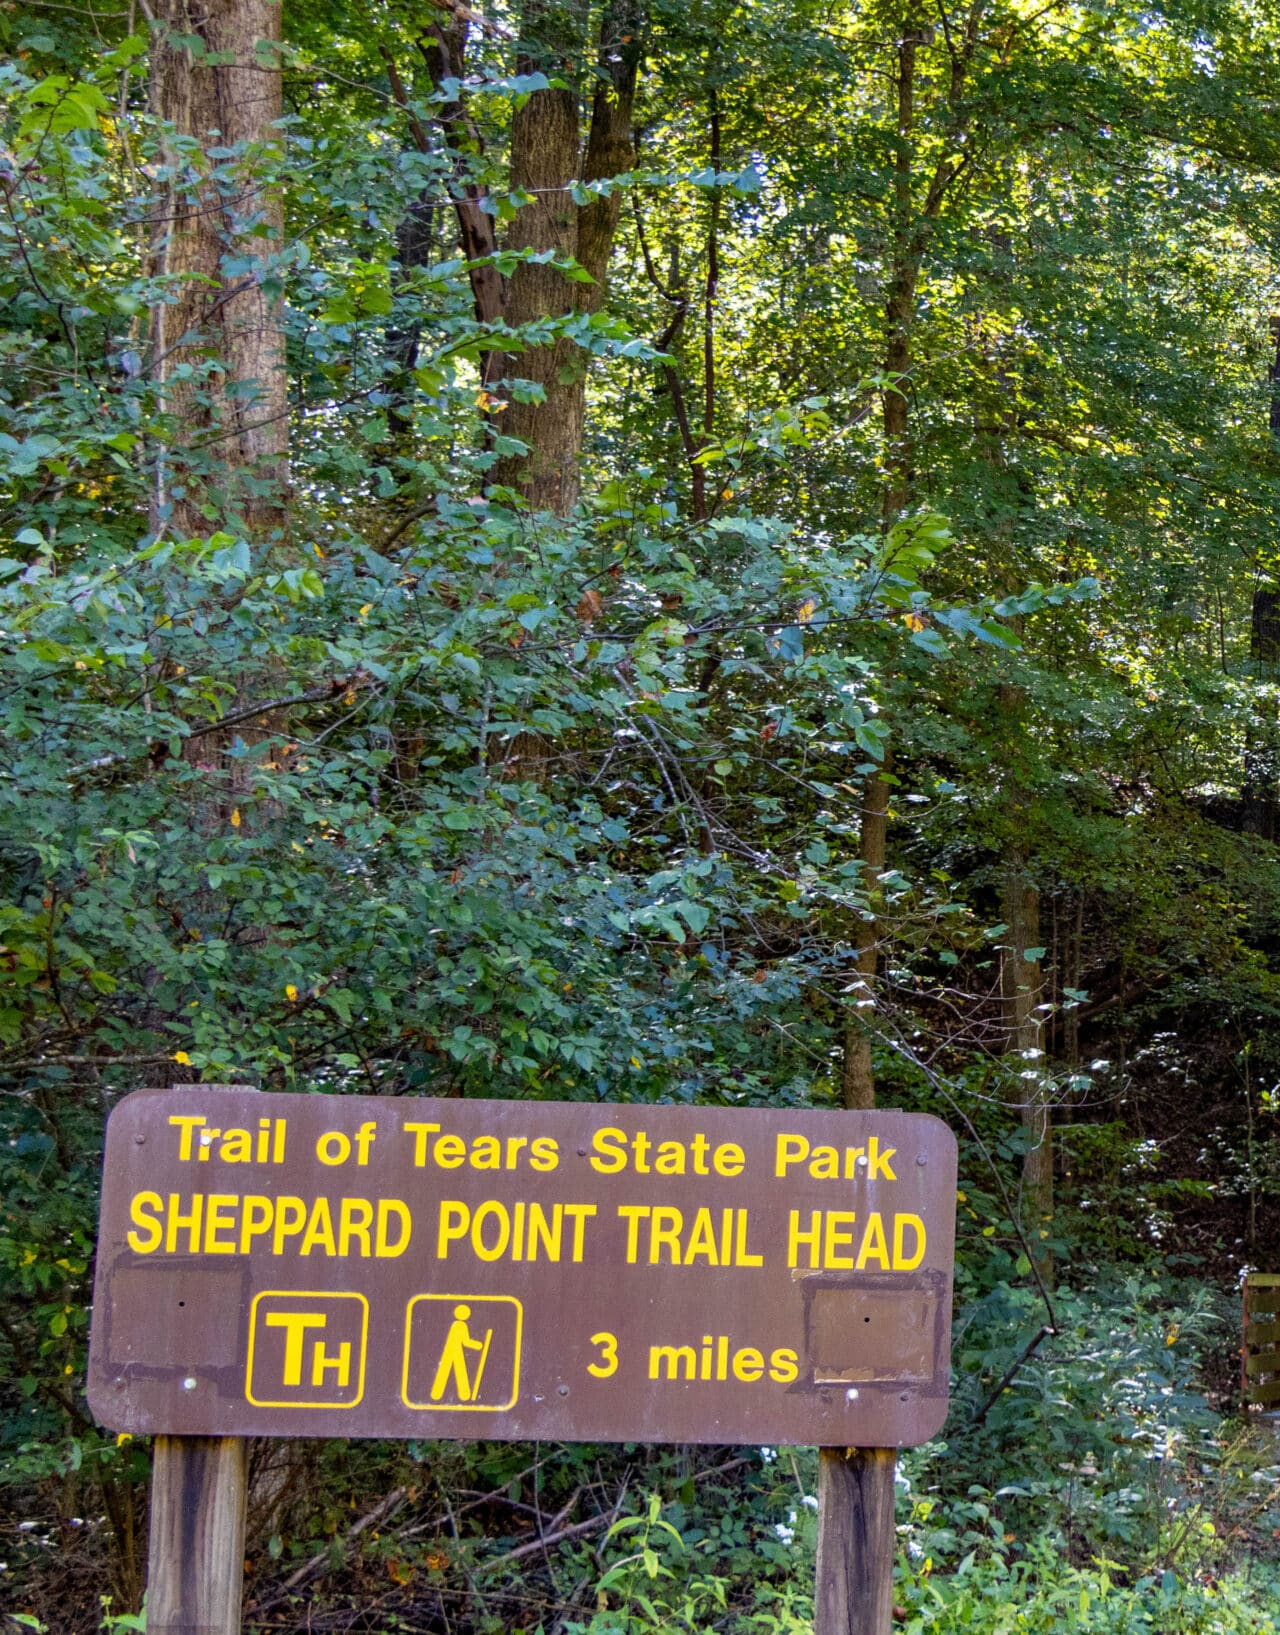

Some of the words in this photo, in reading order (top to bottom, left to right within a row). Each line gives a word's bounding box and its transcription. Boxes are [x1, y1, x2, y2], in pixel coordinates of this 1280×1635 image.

[169, 1117, 287, 1164] Trail
[315, 1120, 377, 1168] of
[403, 1122, 560, 1175] Tears
[589, 1127, 746, 1178] State
[775, 1134, 897, 1181] Park
[126, 1191, 412, 1260] SHEPPARD
[437, 1200, 598, 1264] POINT
[618, 1205, 764, 1268] TRAIL
[786, 1209, 927, 1272] HEAD
[265, 1311, 352, 1387] TH
[586, 1331, 619, 1379] 3
[647, 1335, 799, 1384] miles
